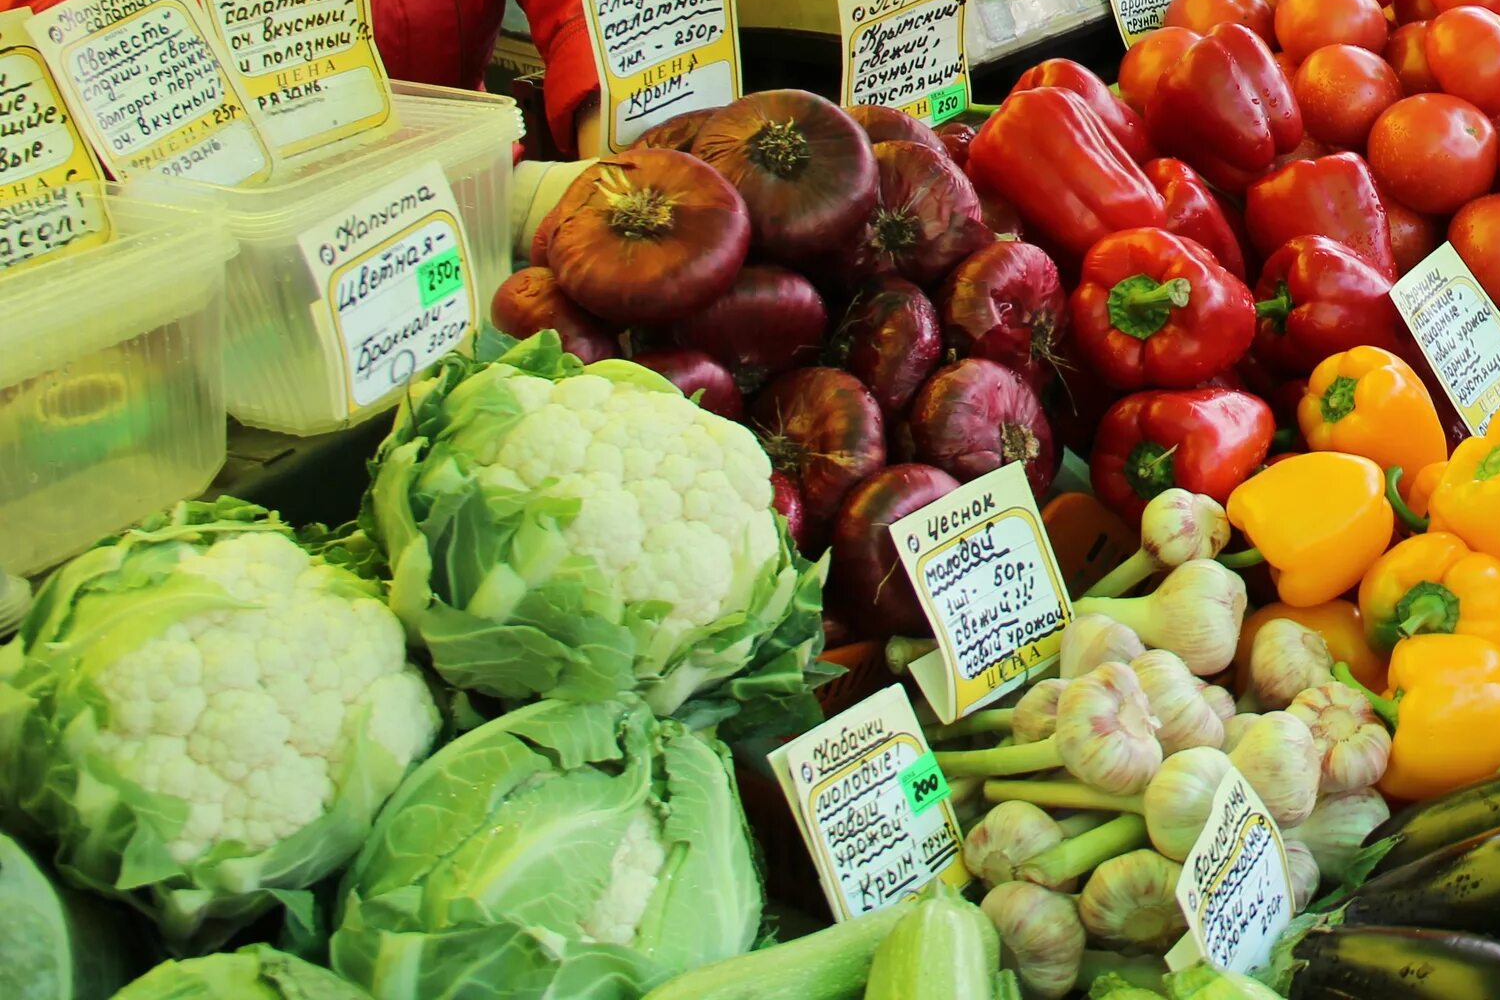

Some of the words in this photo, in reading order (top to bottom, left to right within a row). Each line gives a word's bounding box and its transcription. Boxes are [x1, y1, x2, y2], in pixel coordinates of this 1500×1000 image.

[231, 32, 254, 50] оч.
[239, 61, 250, 73] и
[276, 59, 337, 88] ЦЕНА
[643, 53, 700, 87] ЦЕНА
[938, 95, 958, 114] 250
[112, 133, 136, 151] оч.
[335, 185, 436, 252] Капуста
[928, 493, 996, 540] Чеснок
[926, 521, 995, 587] молодой
[994, 561, 1033, 587] 50р.
[966, 631, 1003, 672] новый
[813, 718, 884, 770] Кабачки
[913, 773, 938, 802] 200
[827, 790, 879, 842] новый
